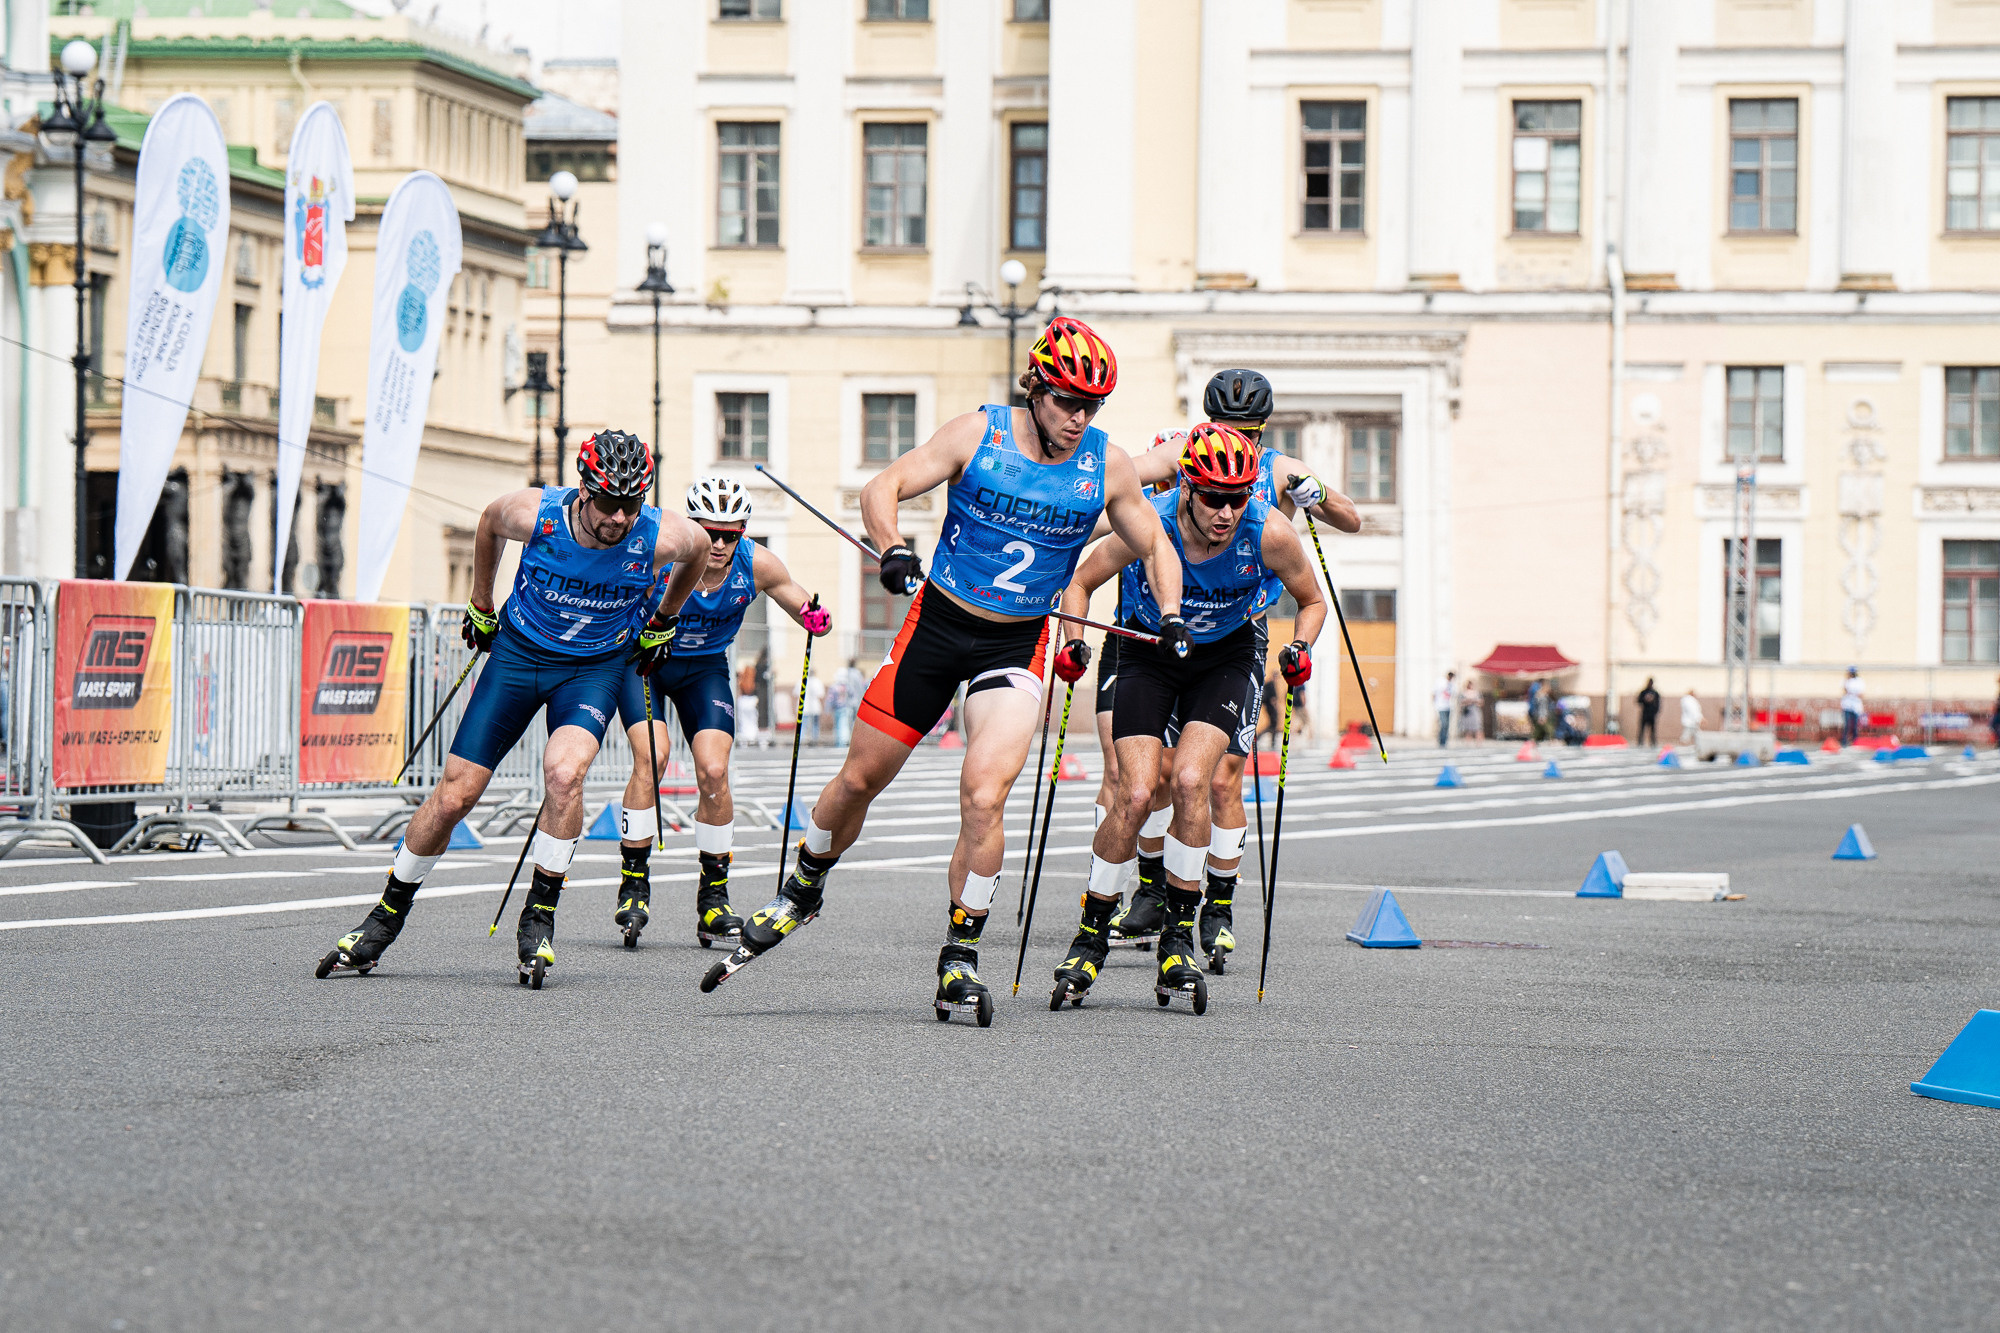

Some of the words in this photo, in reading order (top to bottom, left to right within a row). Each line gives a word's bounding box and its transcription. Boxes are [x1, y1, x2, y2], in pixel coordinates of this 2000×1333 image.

[968, 503, 986, 519] на
[990, 511, 1087, 537] Дворцовой
[976, 486, 1087, 529] СПРИНТ
[950, 524, 960, 547] 2
[992, 540, 1036, 594] 2
[531, 565, 636, 602] СПРИНТ
[1014, 595, 1046, 605] BENDES
[559, 610, 594, 641] 7
[1185, 610, 1217, 633] 6
[85, 630, 146, 667] MS
[679, 632, 708, 649] 5
[327, 644, 384, 677] MS
[318, 689, 347, 705] MASS
[621, 810, 630, 835] 5
[1237, 829, 1248, 851] 4
[989, 874, 1001, 905] 2
